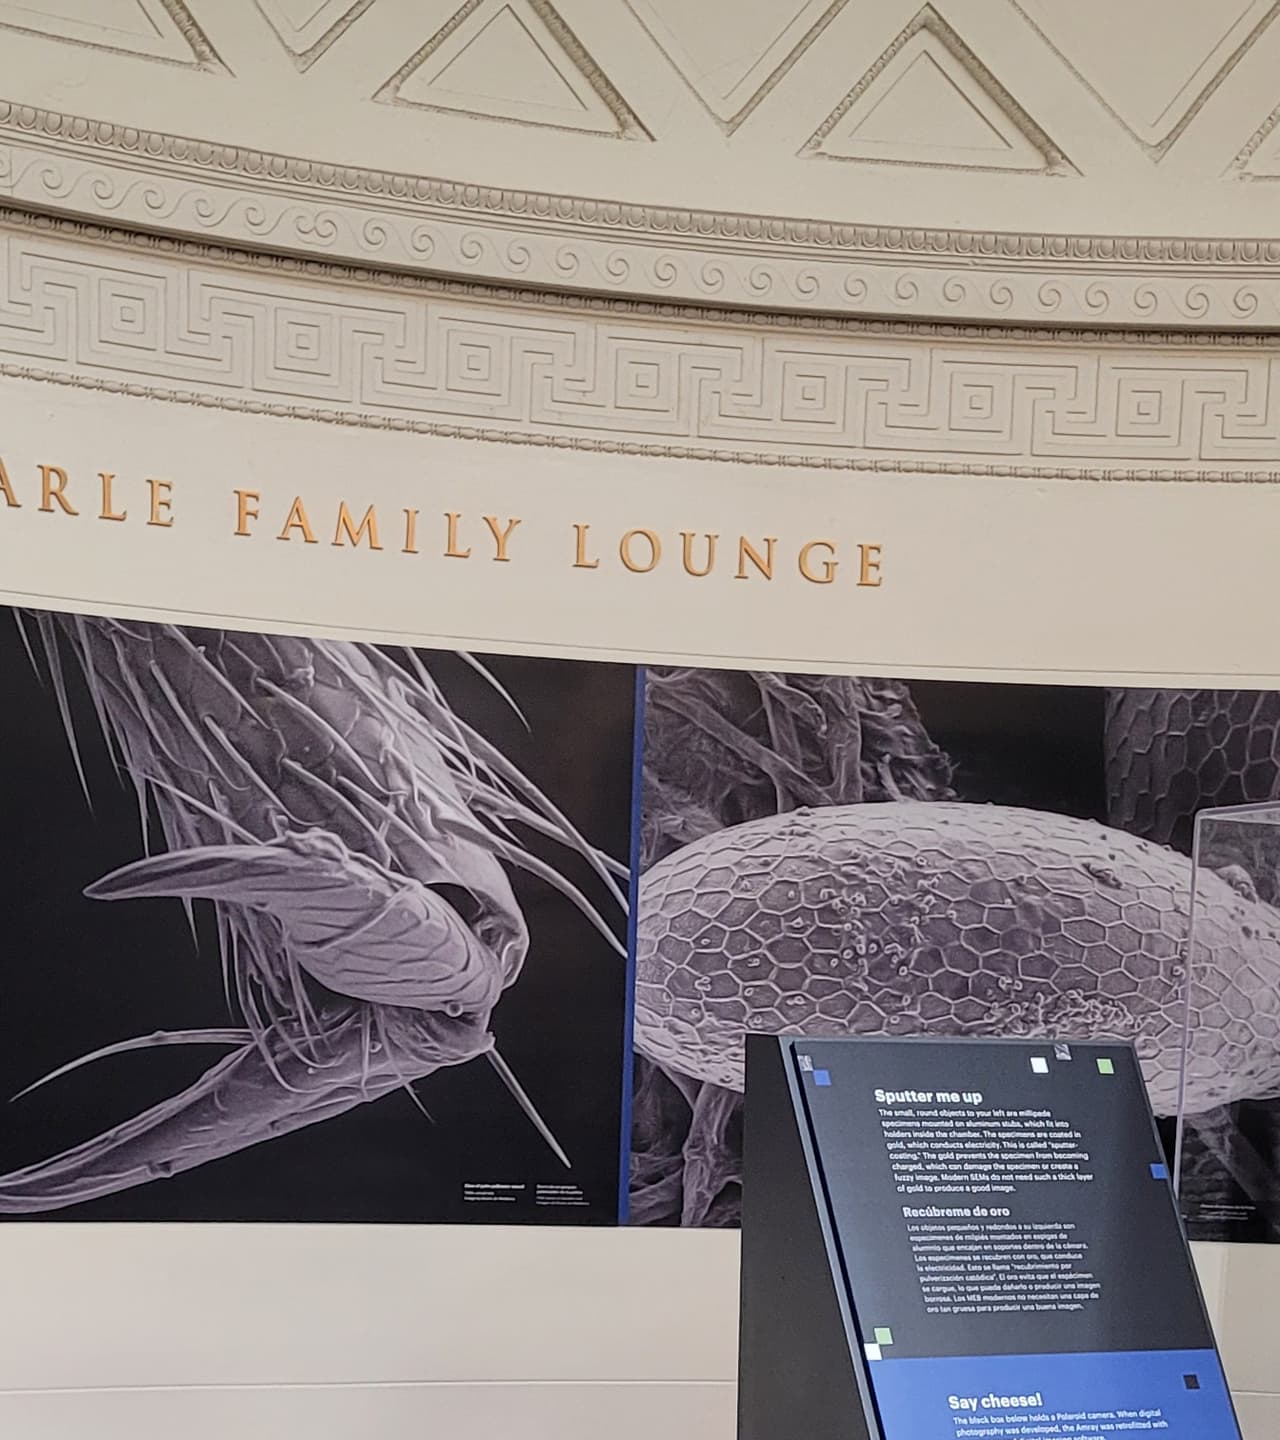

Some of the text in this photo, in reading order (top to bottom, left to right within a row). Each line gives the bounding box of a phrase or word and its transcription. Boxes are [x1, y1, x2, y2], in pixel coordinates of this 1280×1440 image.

[232, 489, 521, 562] FAMILY
[572, 523, 883, 587] LOUNGE
[874, 1088, 983, 1105] Sputter me up
[902, 1206, 1010, 1218] Recúbreme de oro
[948, 1392, 1042, 1411] Say cheese!
